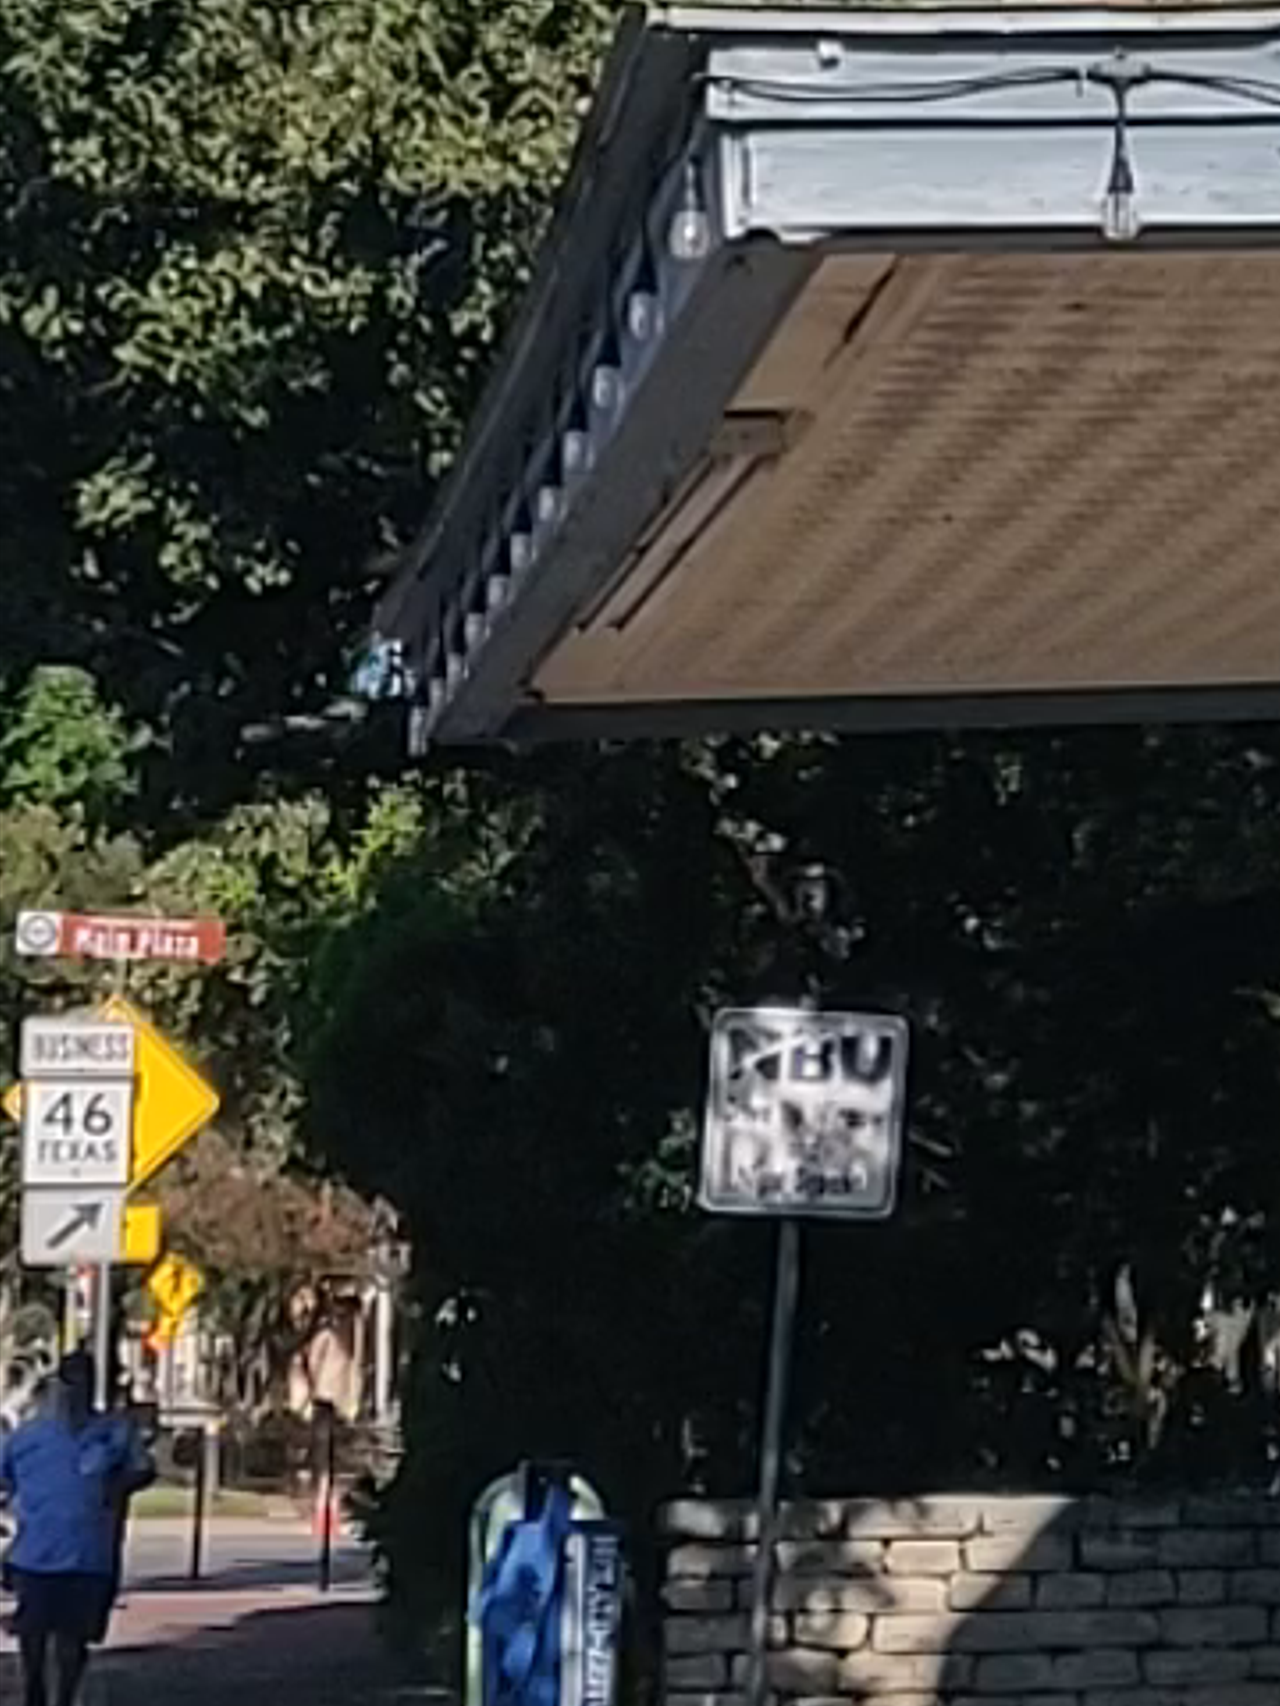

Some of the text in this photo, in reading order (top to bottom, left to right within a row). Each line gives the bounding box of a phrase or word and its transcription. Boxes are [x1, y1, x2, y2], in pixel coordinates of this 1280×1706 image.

[73, 927, 131, 958] Main
[137, 931, 199, 959] Plaza
[32, 1033, 130, 1064] BUSINESS
[42, 1091, 113, 1137] 46
[37, 1138, 118, 1164] TEXAS
